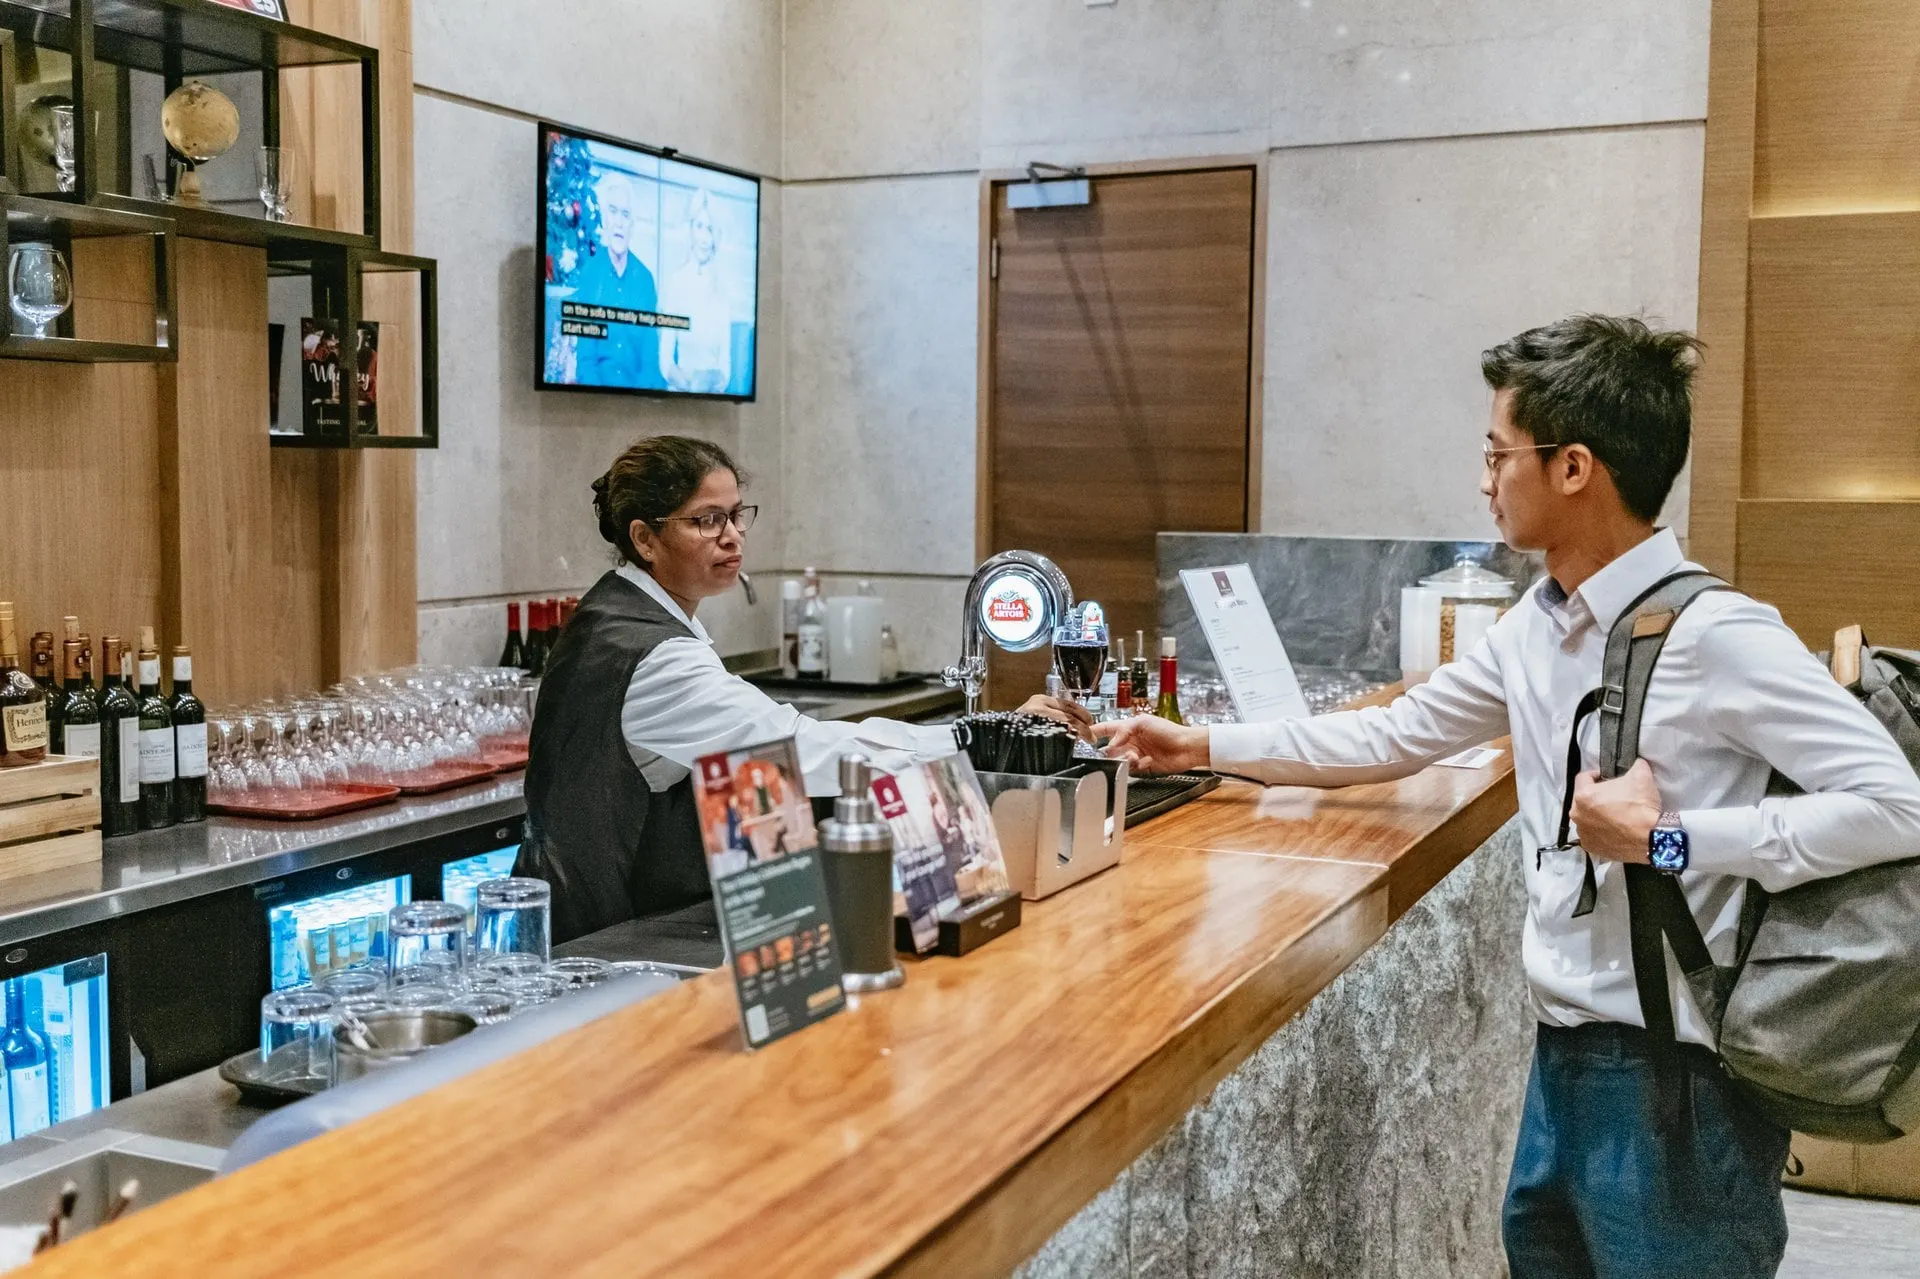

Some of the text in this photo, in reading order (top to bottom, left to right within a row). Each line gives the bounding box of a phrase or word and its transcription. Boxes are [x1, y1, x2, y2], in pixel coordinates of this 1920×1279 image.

[563, 304, 574, 314] on
[575, 305, 588, 316] the
[589, 306, 606, 318] sofa
[606, 309, 616, 320] to
[617, 311, 637, 324] really
[563, 322, 607, 337] start with a
[310, 363, 370, 391] Whiey
[994, 602, 1024, 610] STELLA
[993, 610, 1024, 618] ARTOIS
